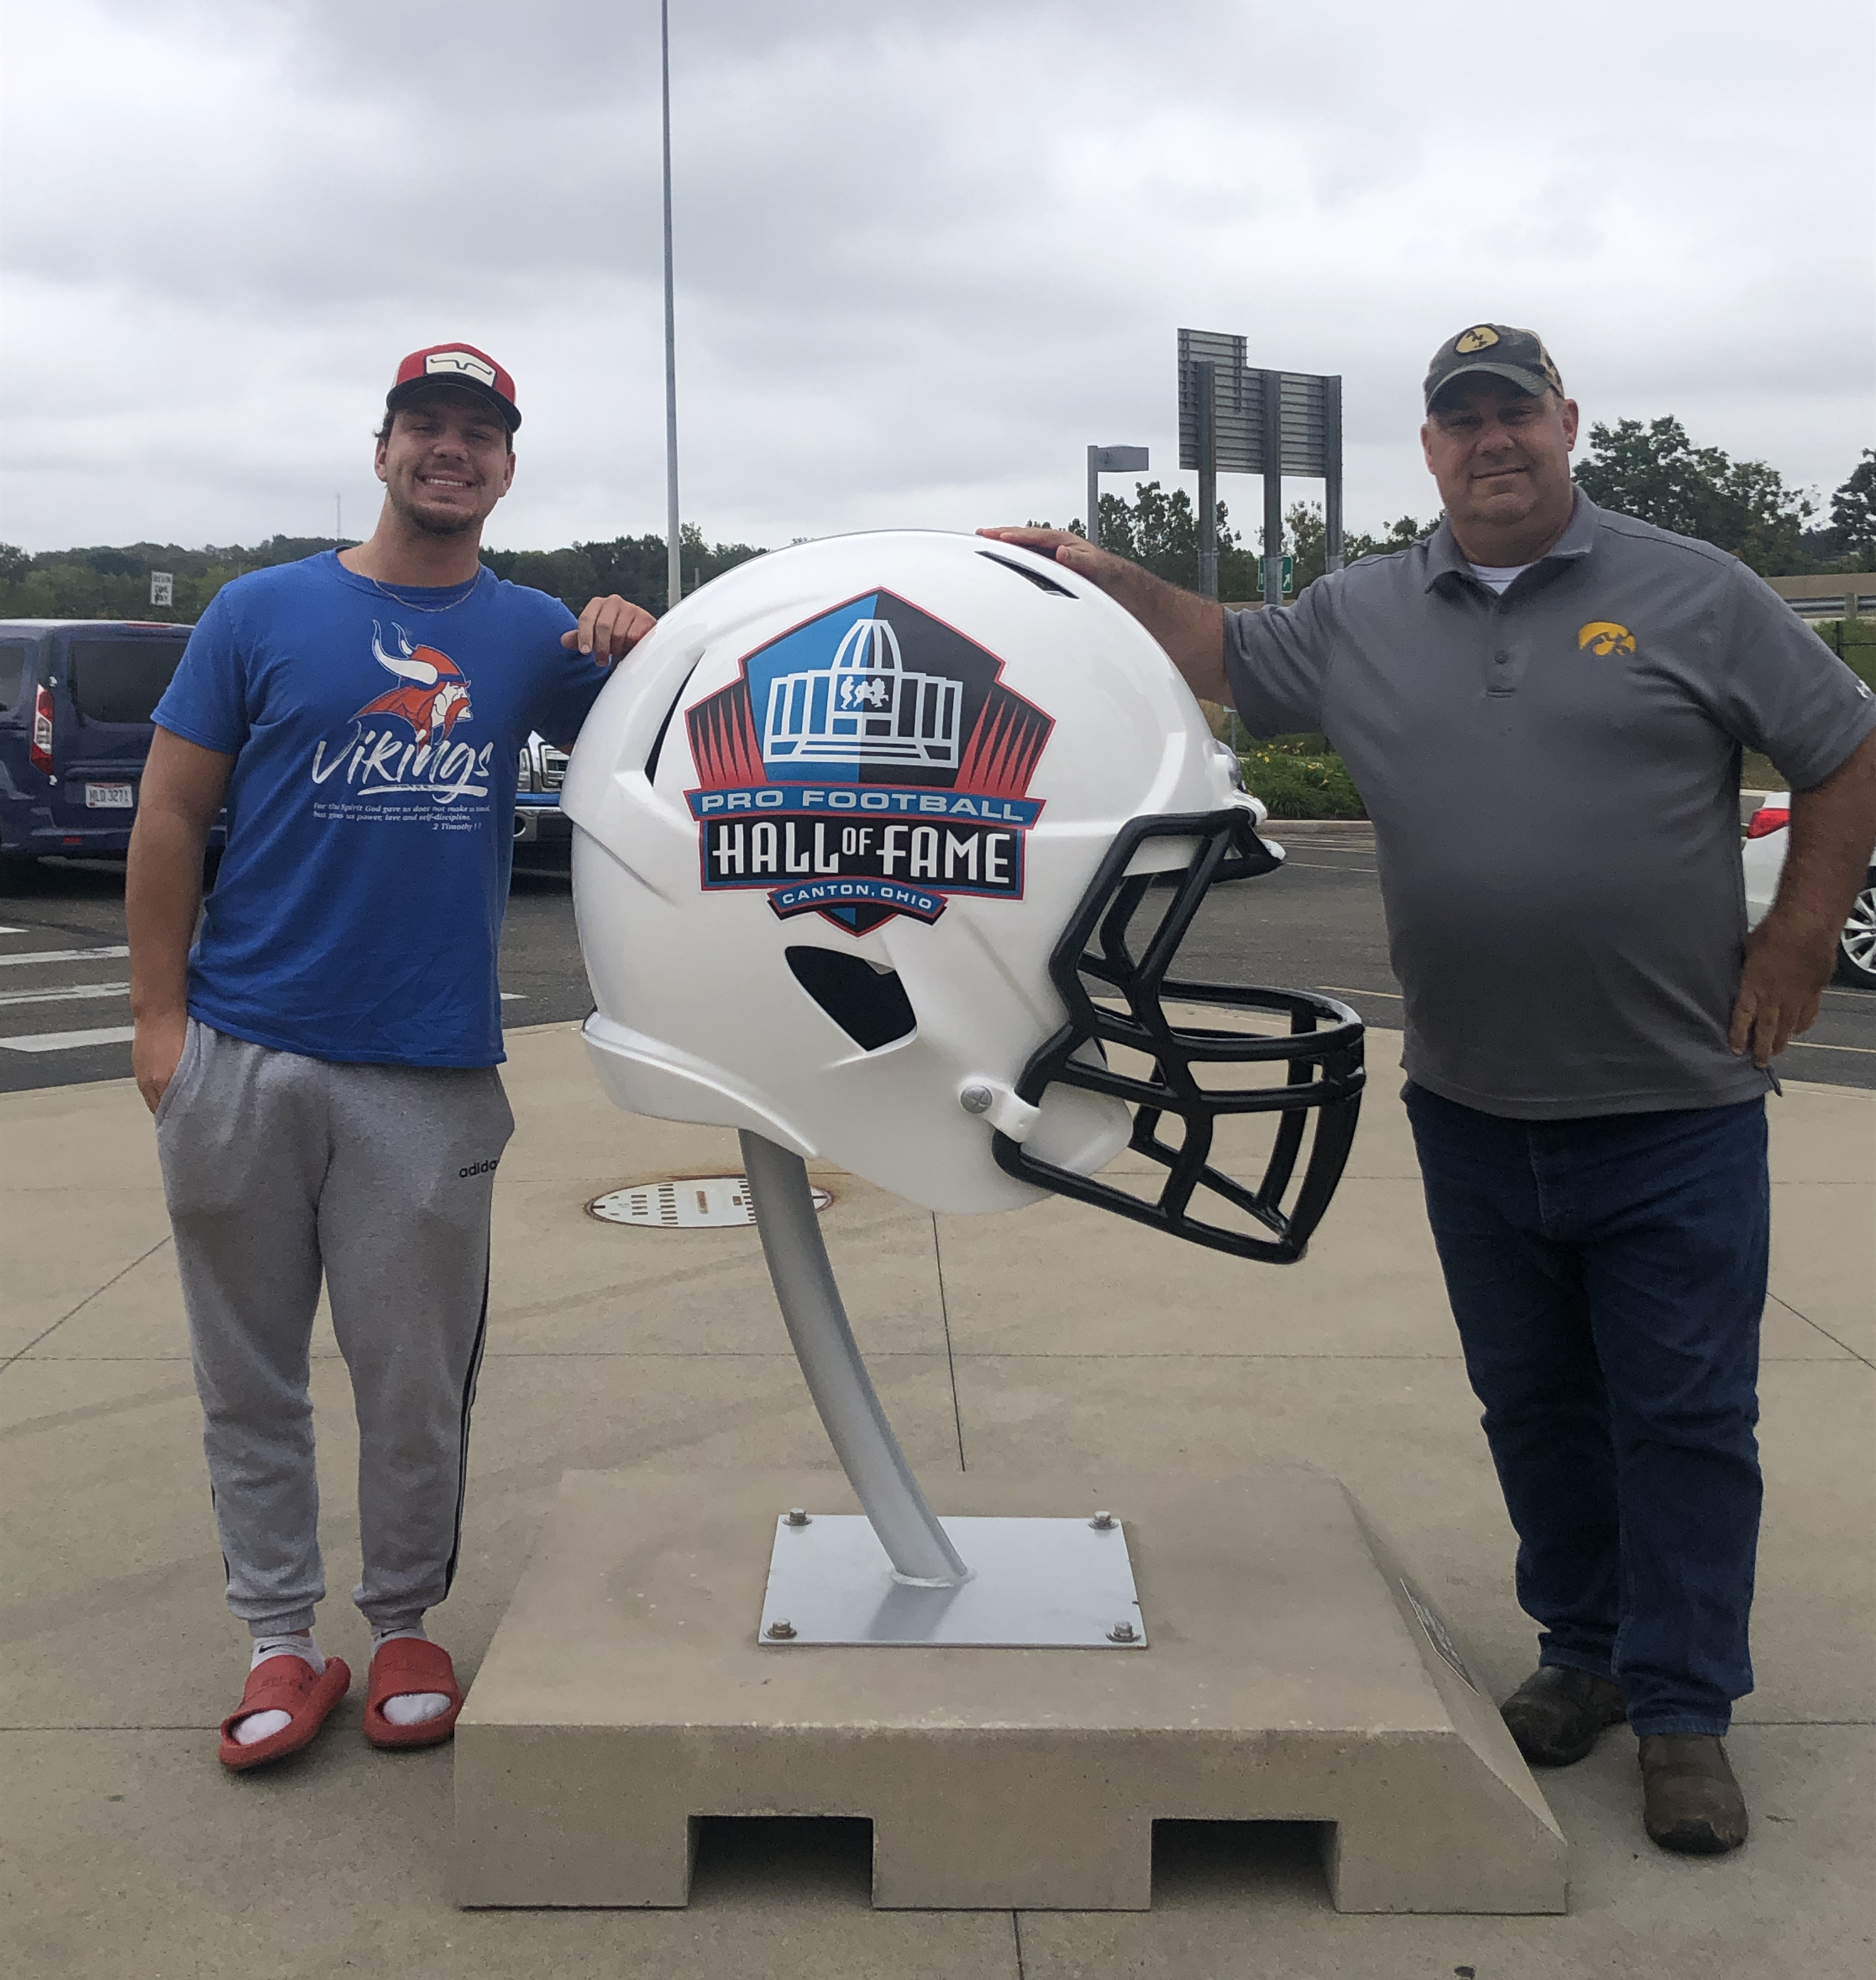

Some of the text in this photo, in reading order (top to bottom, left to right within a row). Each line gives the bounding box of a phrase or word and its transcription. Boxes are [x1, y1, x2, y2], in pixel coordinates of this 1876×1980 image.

[311, 720, 494, 804] Vikings
[341, 803, 363, 812] Spirit
[701, 790, 1024, 821] PRO FOOTBALL
[441, 823, 473, 832] Timothy
[712, 822, 1011, 883] HALL OF FAME
[782, 883, 932, 909] CANTON, OHIO
[459, 1159, 499, 1177] adida
